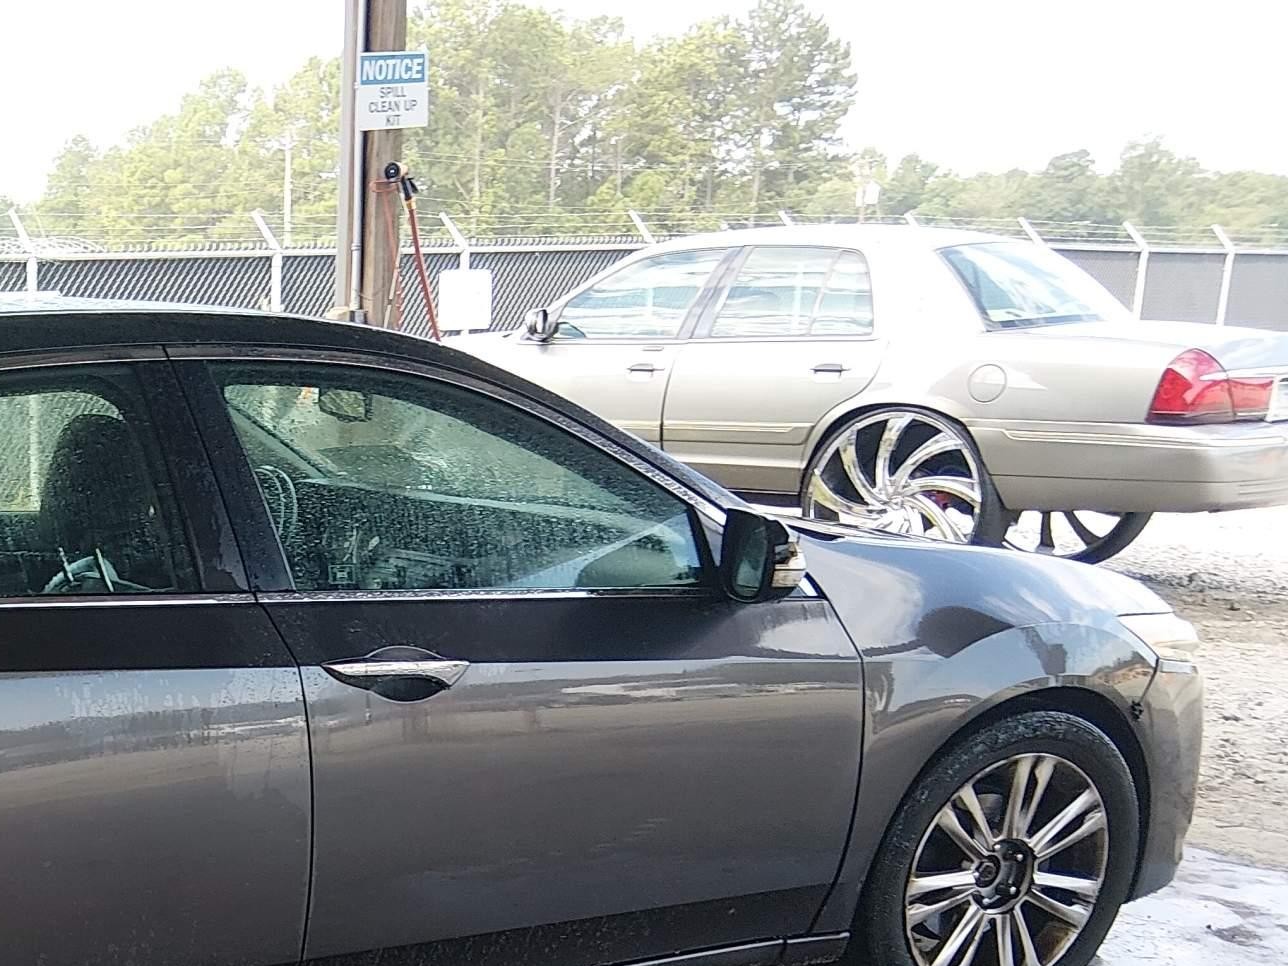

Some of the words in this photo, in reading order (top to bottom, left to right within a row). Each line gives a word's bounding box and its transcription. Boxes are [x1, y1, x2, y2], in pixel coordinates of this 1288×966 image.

[362, 58, 424, 81] NOTICE
[379, 86, 407, 99] SPILL
[368, 101, 400, 113] CLEAN
[403, 99, 418, 112] UP
[385, 114, 401, 126] KIT
